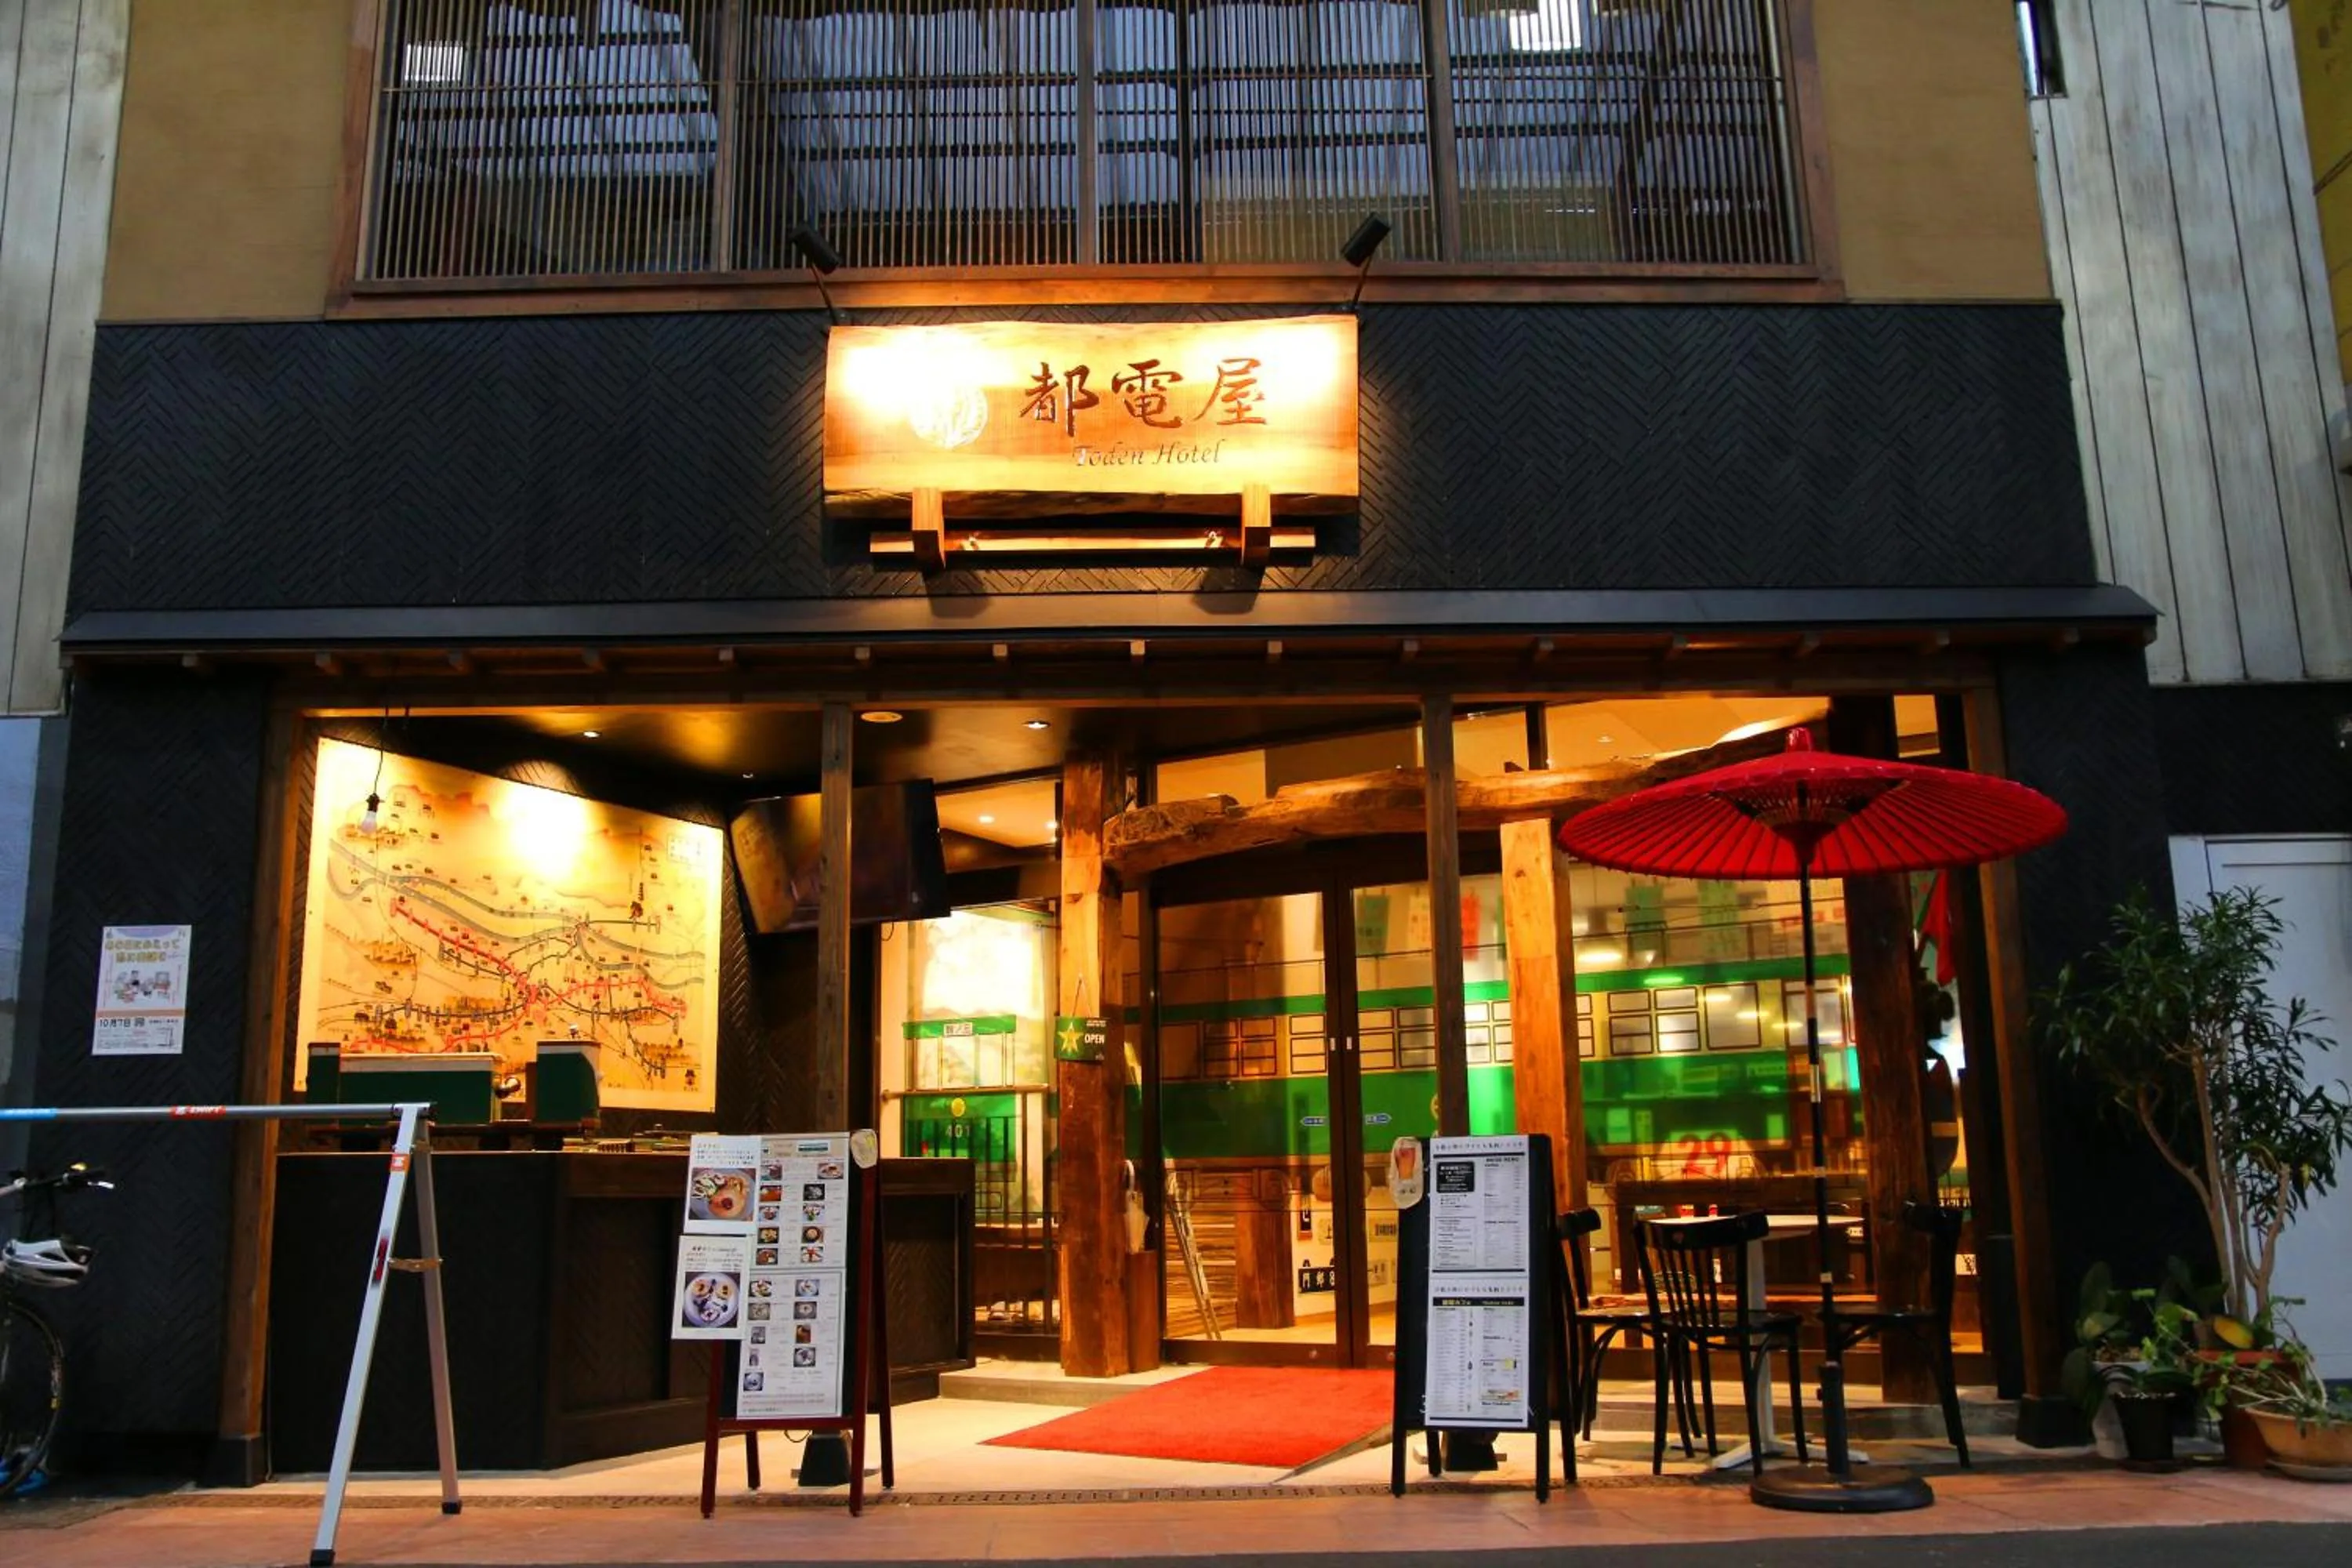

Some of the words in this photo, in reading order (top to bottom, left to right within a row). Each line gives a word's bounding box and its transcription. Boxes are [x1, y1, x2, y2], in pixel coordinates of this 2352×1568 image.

[1019, 358, 1267, 437] 都電屋
[1073, 441, 1144, 466] Toden
[1152, 437, 1227, 464] Hotel
[1084, 1033, 1105, 1045] OPEN
